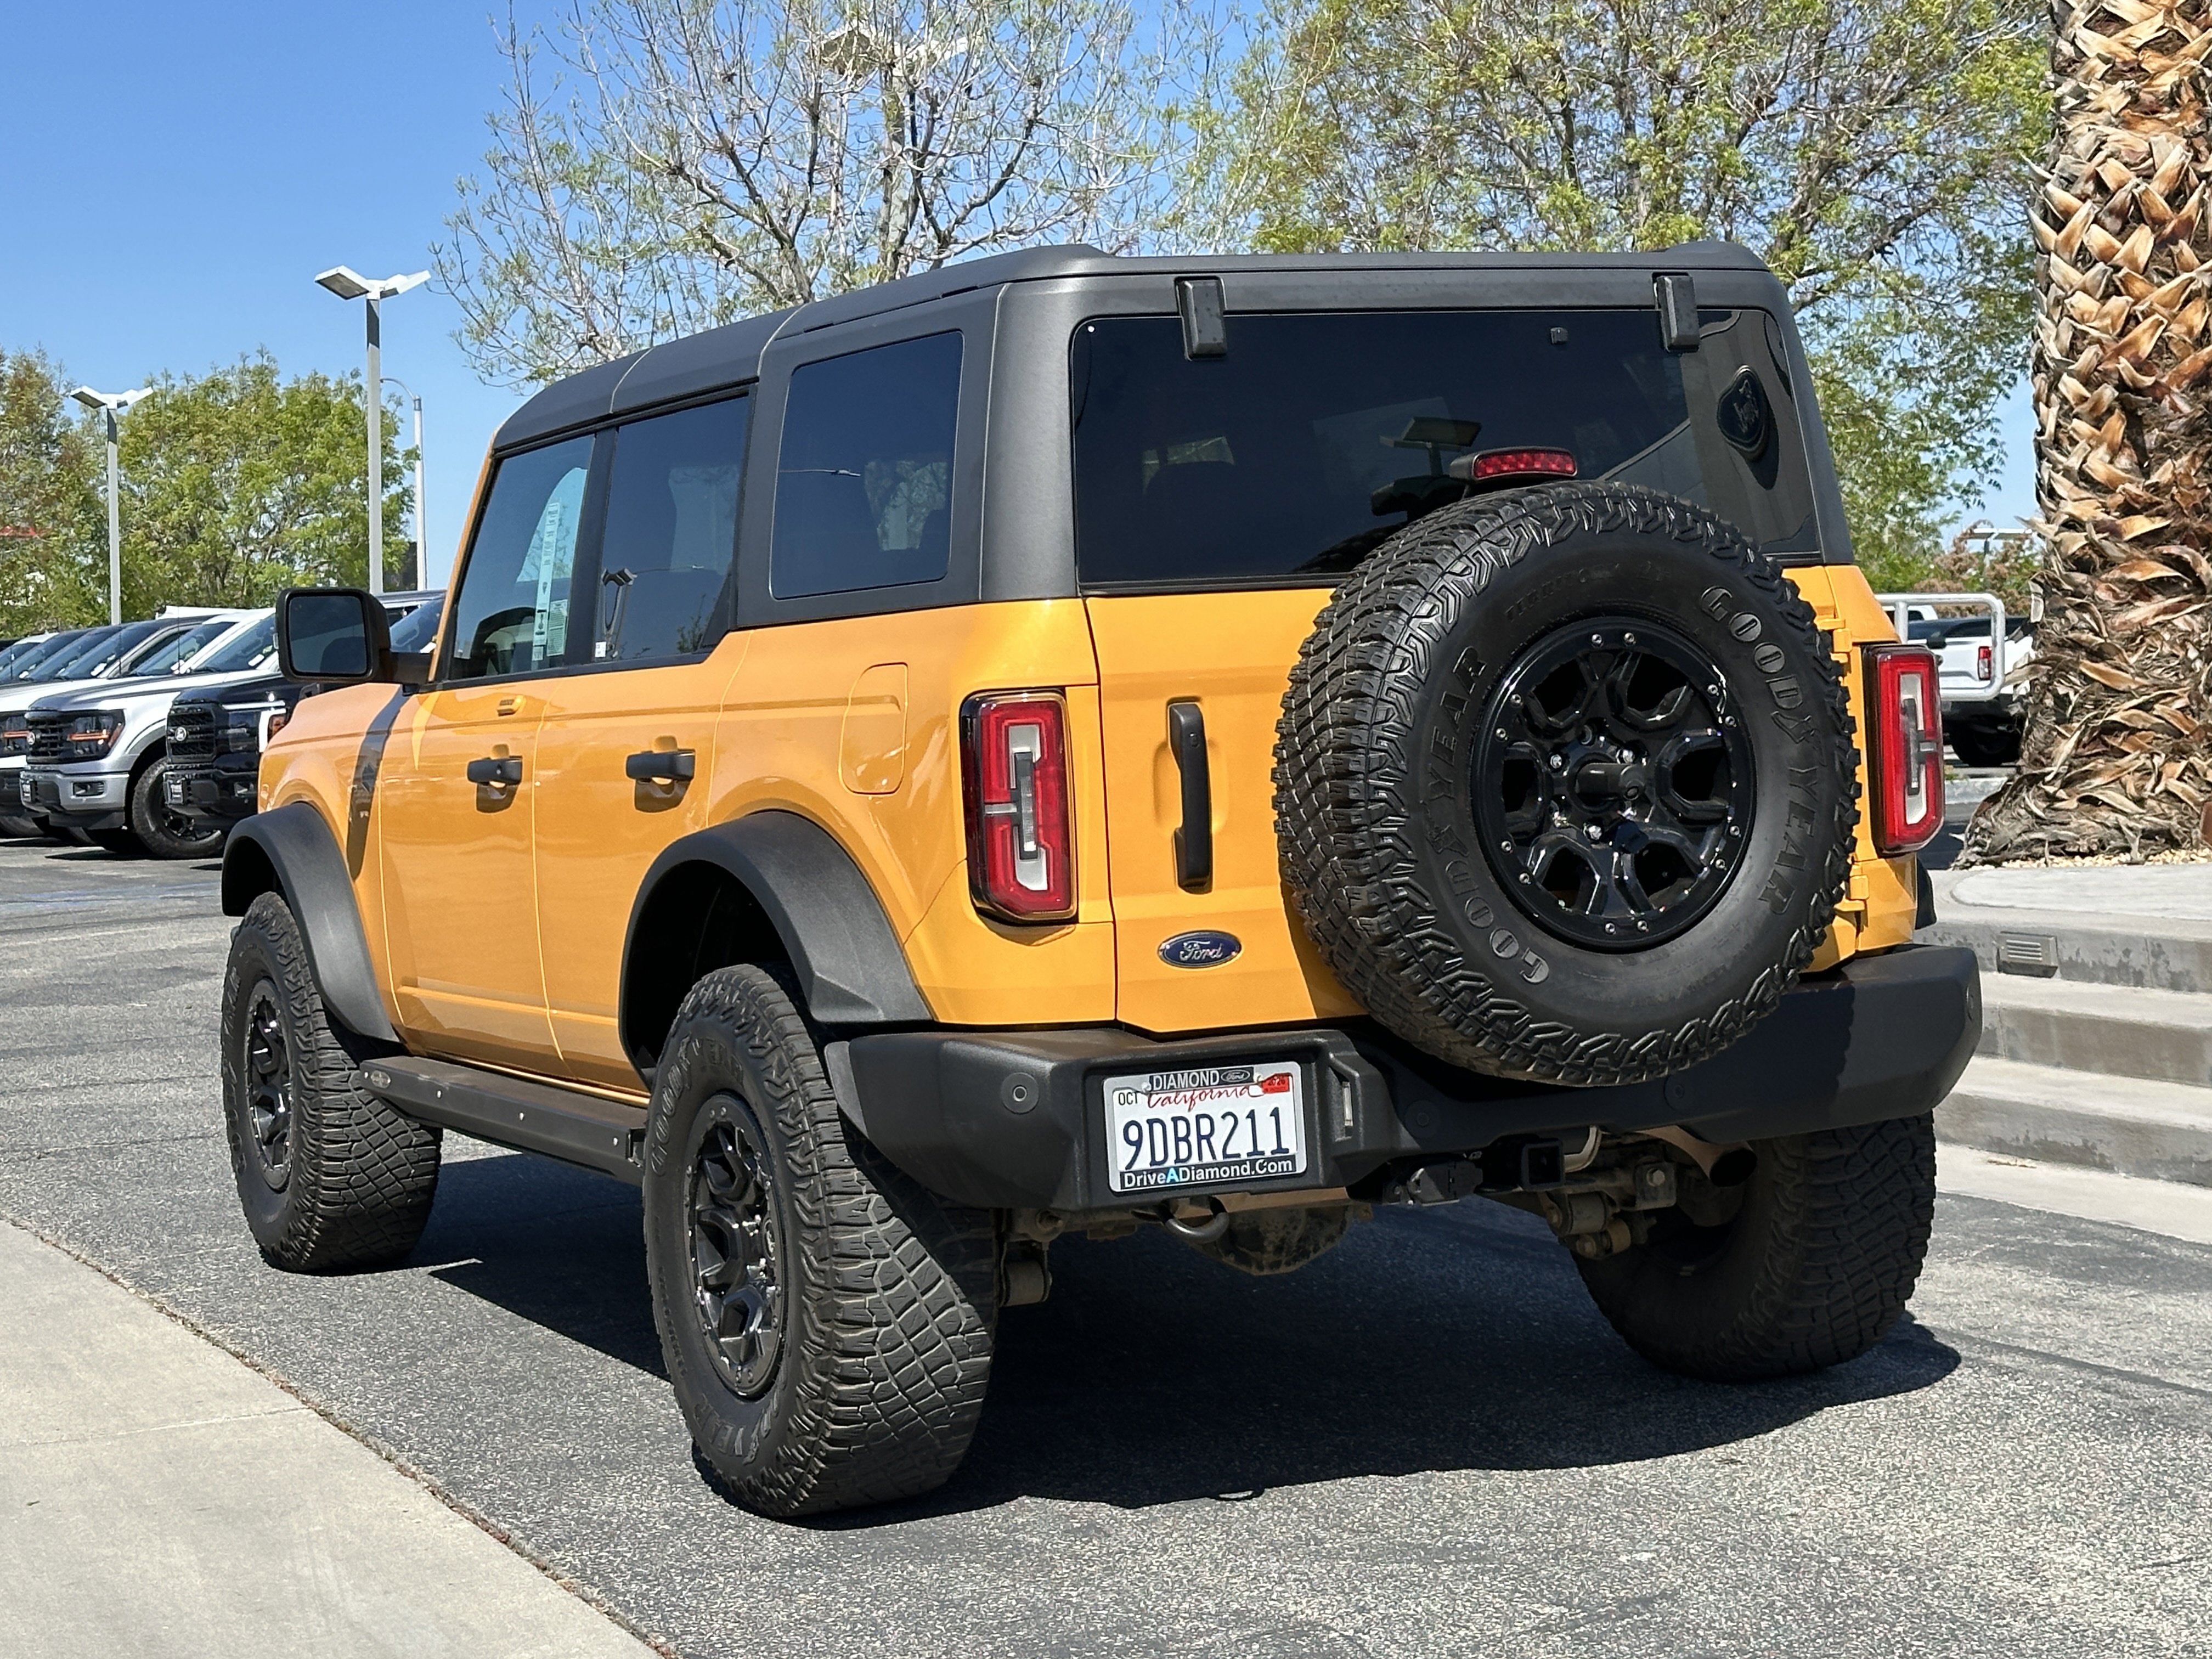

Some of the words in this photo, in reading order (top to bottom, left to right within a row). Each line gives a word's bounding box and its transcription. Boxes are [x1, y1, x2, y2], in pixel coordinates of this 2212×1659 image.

[1180, 940, 1223, 961] Ford
[1153, 1070, 1220, 1091] DIAMOND
[1122, 1107, 1290, 1170] 9DBR211
[1124, 1159, 1293, 1188] DriveADiamond.Com
